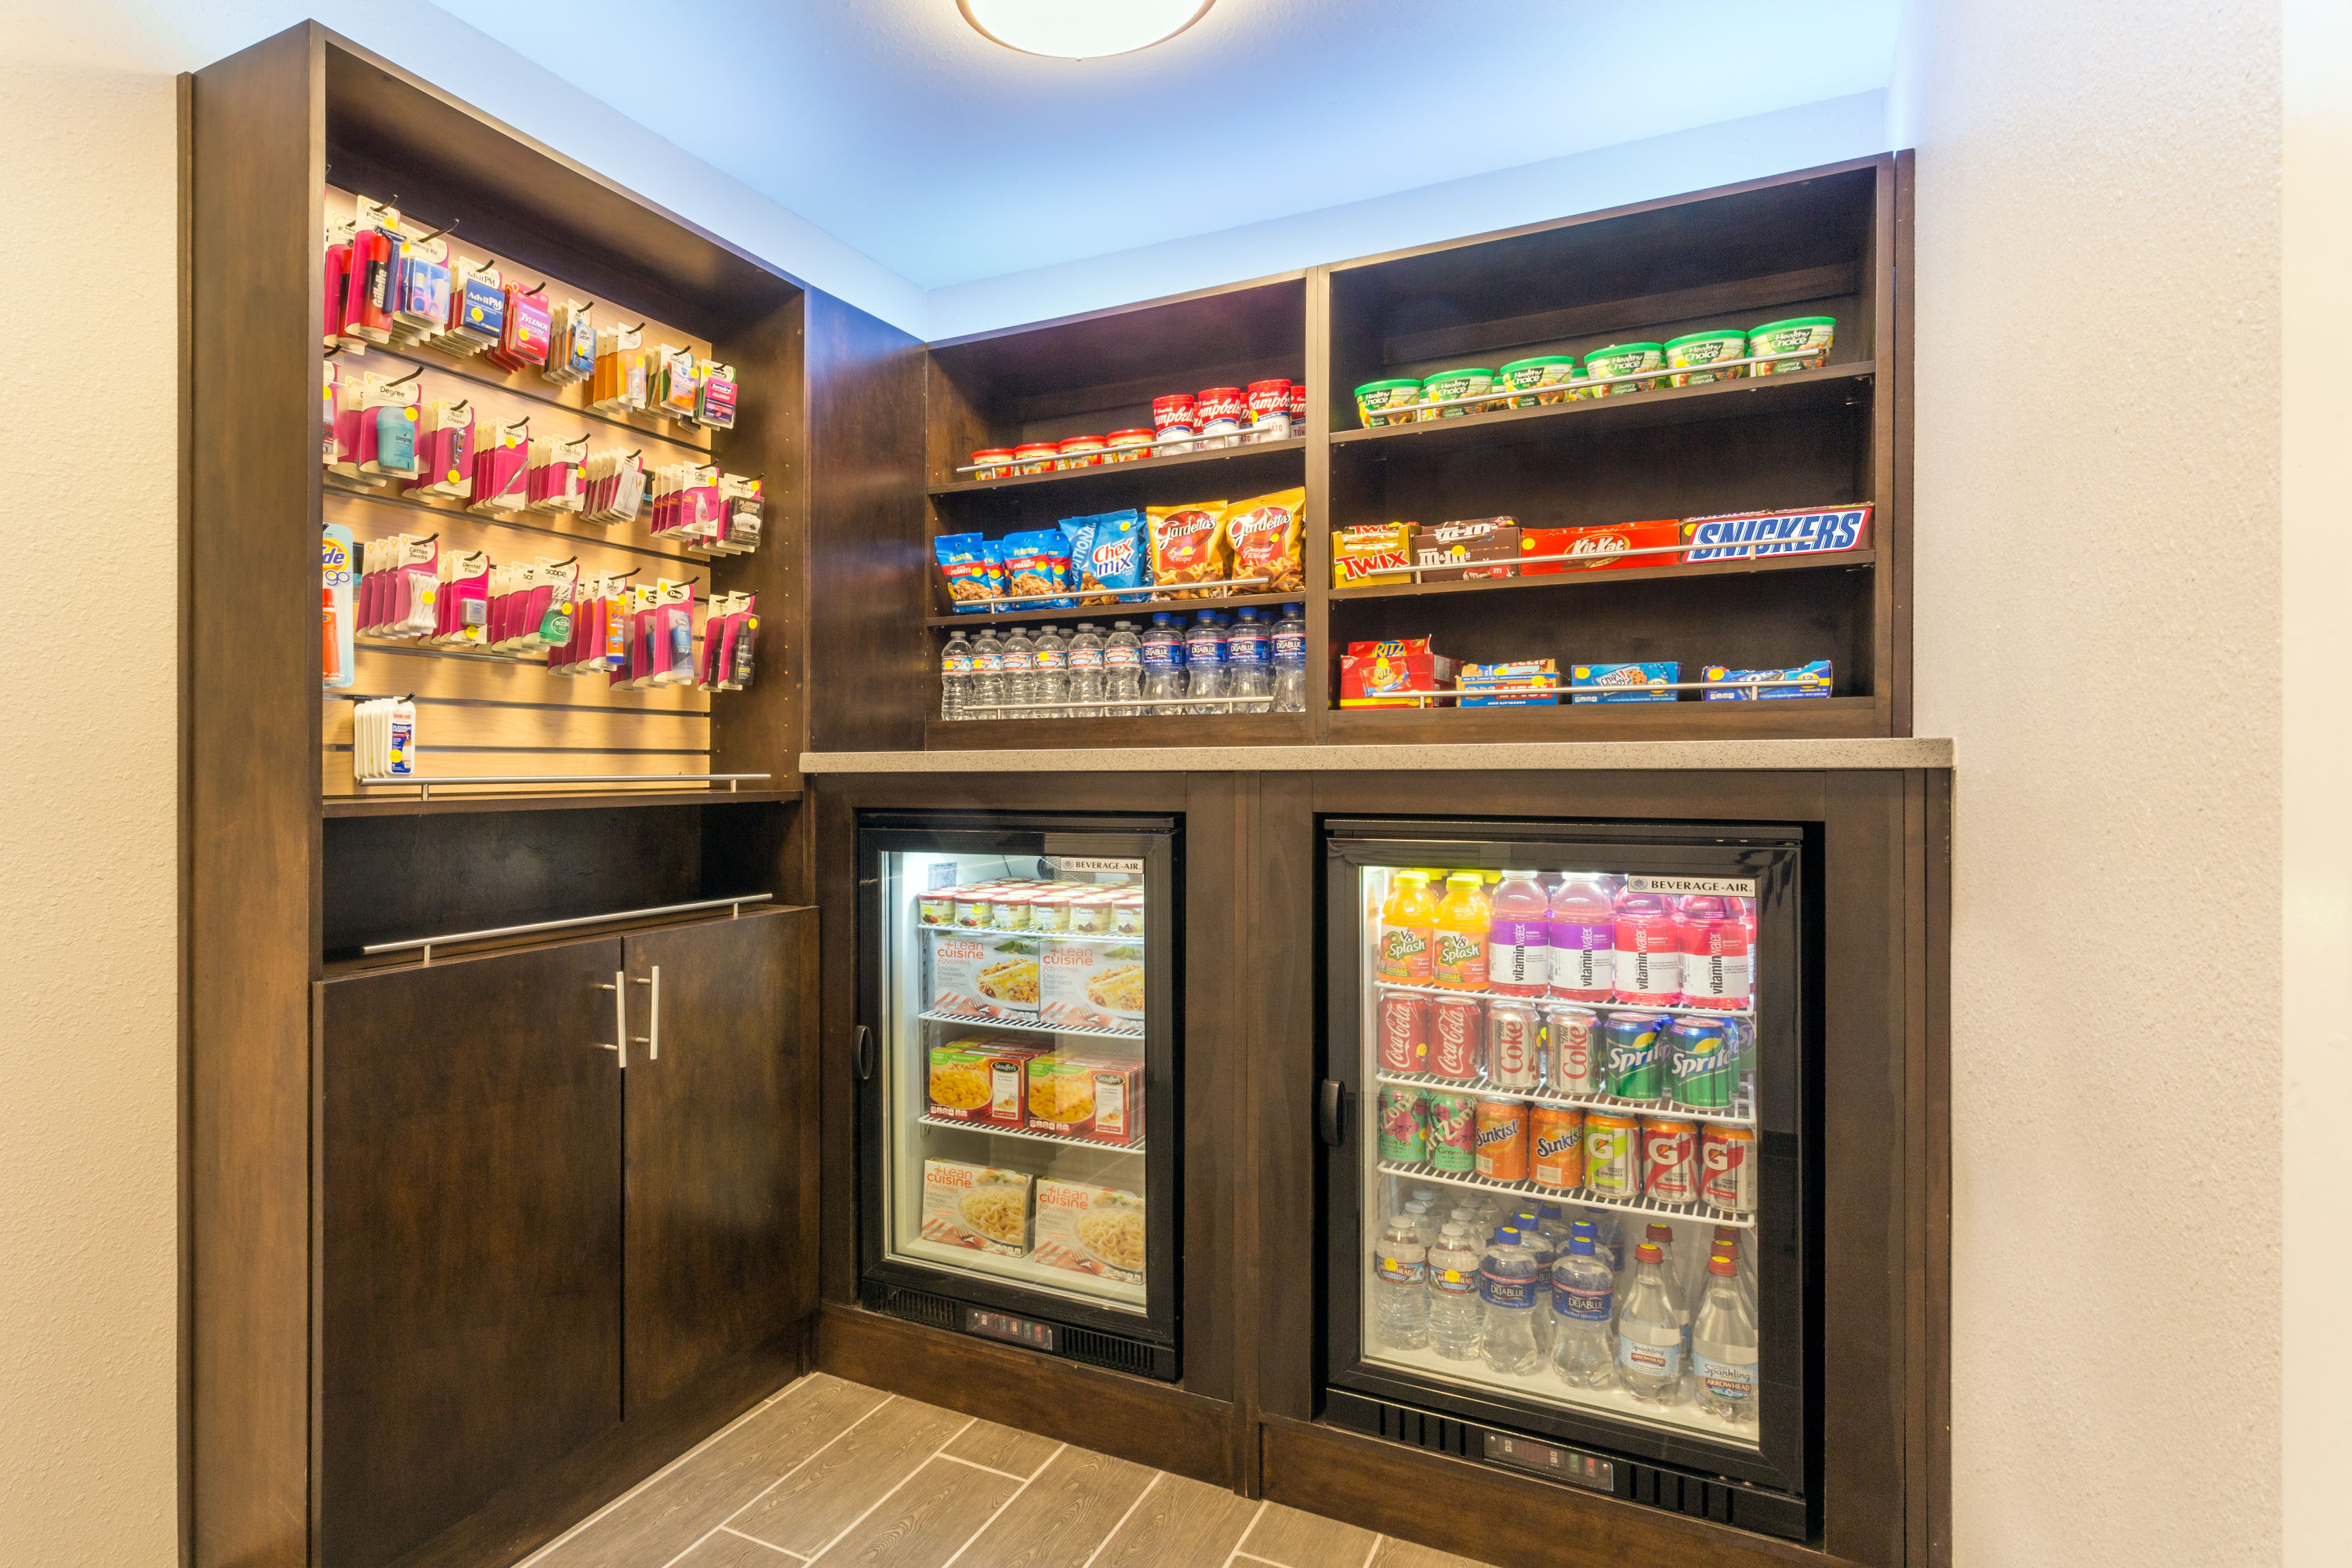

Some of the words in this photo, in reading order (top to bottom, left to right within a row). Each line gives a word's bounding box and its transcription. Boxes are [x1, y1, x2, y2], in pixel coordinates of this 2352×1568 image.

[373, 269, 387, 307] Gillette
[521, 312, 549, 331] TYLENOL
[1775, 330, 1809, 340] Healthy
[1770, 336, 1807, 347] Choice
[1689, 343, 1722, 354] Healthy
[1612, 354, 1643, 363] Healthy
[1685, 350, 1719, 360] Choice
[1607, 359, 1642, 370] Choice
[1512, 375, 1541, 384] Choice
[1514, 368, 1542, 379] Healthy
[1441, 380, 1469, 390] Healthy
[380, 386, 405, 397] Degree
[1365, 390, 1391, 399] Healthy
[1439, 387, 1467, 396] Choice
[1364, 397, 1388, 406] Choice
[1154, 517, 1217, 550] Gardetto's
[1229, 512, 1292, 548] Gardetto's
[1691, 512, 1862, 560] SNICKERS
[1094, 539, 1131, 562] Chex
[1014, 561, 1036, 570] PEANUTS
[1099, 553, 1131, 575] mix
[1374, 643, 1402, 657] RITZ
[1076, 861, 1139, 870] BEVERAGE-AIR
[1651, 880, 1748, 892] BEVERAGE-AIR
[1401, 931, 1414, 942] V8
[1453, 935, 1466, 947] V8
[954, 941, 983, 950] Lean
[1389, 939, 1425, 958] Splash
[1062, 947, 1093, 957] Lean
[1443, 944, 1479, 964] Splash
[1501, 1021, 1523, 1074] Coke
[1563, 1025, 1588, 1080] Coke
[1476, 1120, 1518, 1147] Sunkist
[1537, 1124, 1582, 1159] Sunkist
[1587, 1132, 1614, 1160] G
[1438, 1146, 1461, 1156] Green
[1648, 1138, 1679, 1166] G
[1703, 1142, 1728, 1171] G
[943, 1167, 972, 1179] Lean
[1058, 1188, 1088, 1201] Lean
[1631, 1342, 1664, 1356] Sparkling
[1704, 1363, 1751, 1382] Sparkling
[1706, 1378, 1751, 1392] ARROWHEAD
